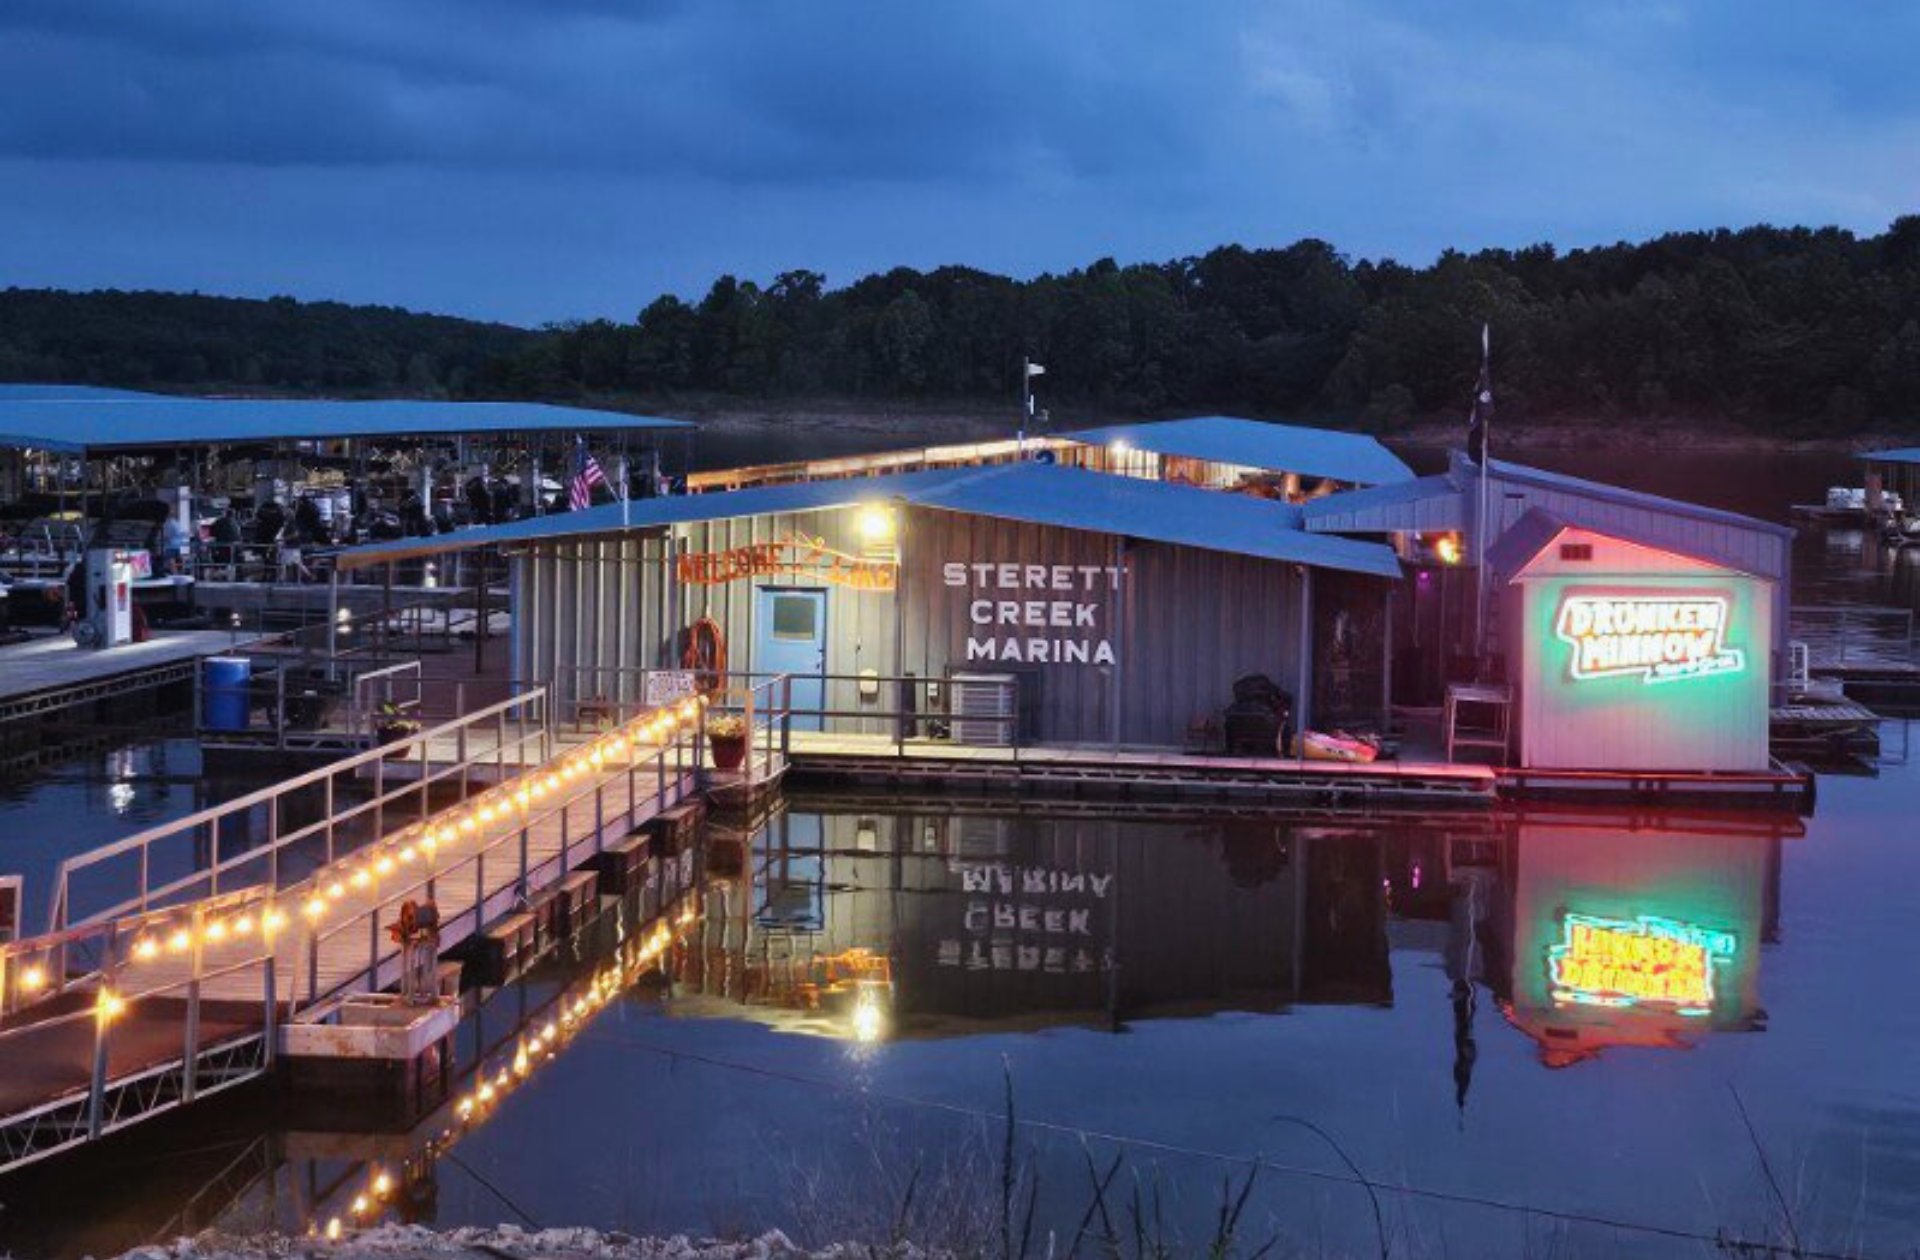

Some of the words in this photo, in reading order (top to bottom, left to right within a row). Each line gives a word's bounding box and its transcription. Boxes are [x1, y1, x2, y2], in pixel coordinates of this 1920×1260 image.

[943, 562, 1128, 591] STERETT
[970, 599, 1098, 627] CREEK
[967, 637, 1116, 665] MARINA
[1580, 630, 1716, 671] MINNOW
